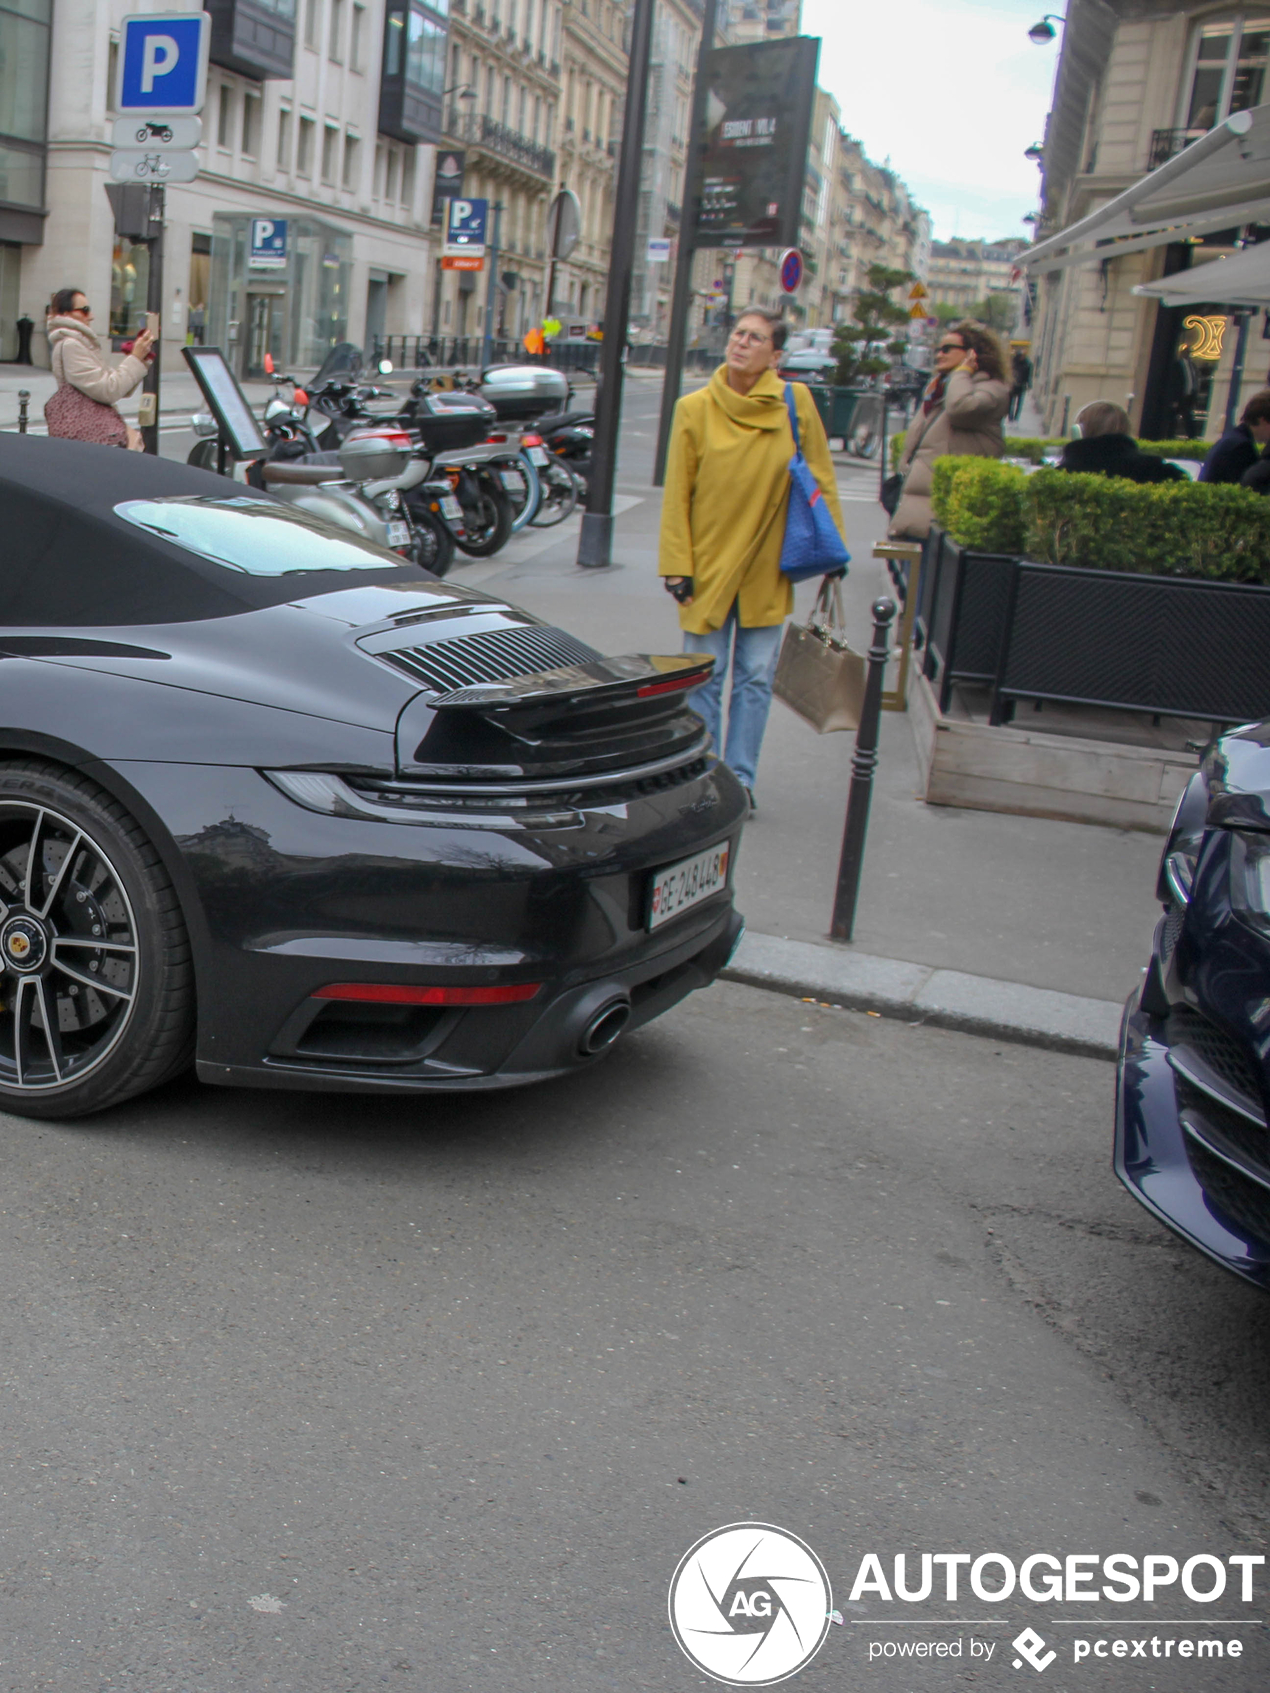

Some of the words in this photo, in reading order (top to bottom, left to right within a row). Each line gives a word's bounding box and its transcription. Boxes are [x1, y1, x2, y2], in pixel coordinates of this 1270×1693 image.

[141, 35, 180, 94] P
[450, 200, 472, 228] P
[254, 220, 275, 248] P
